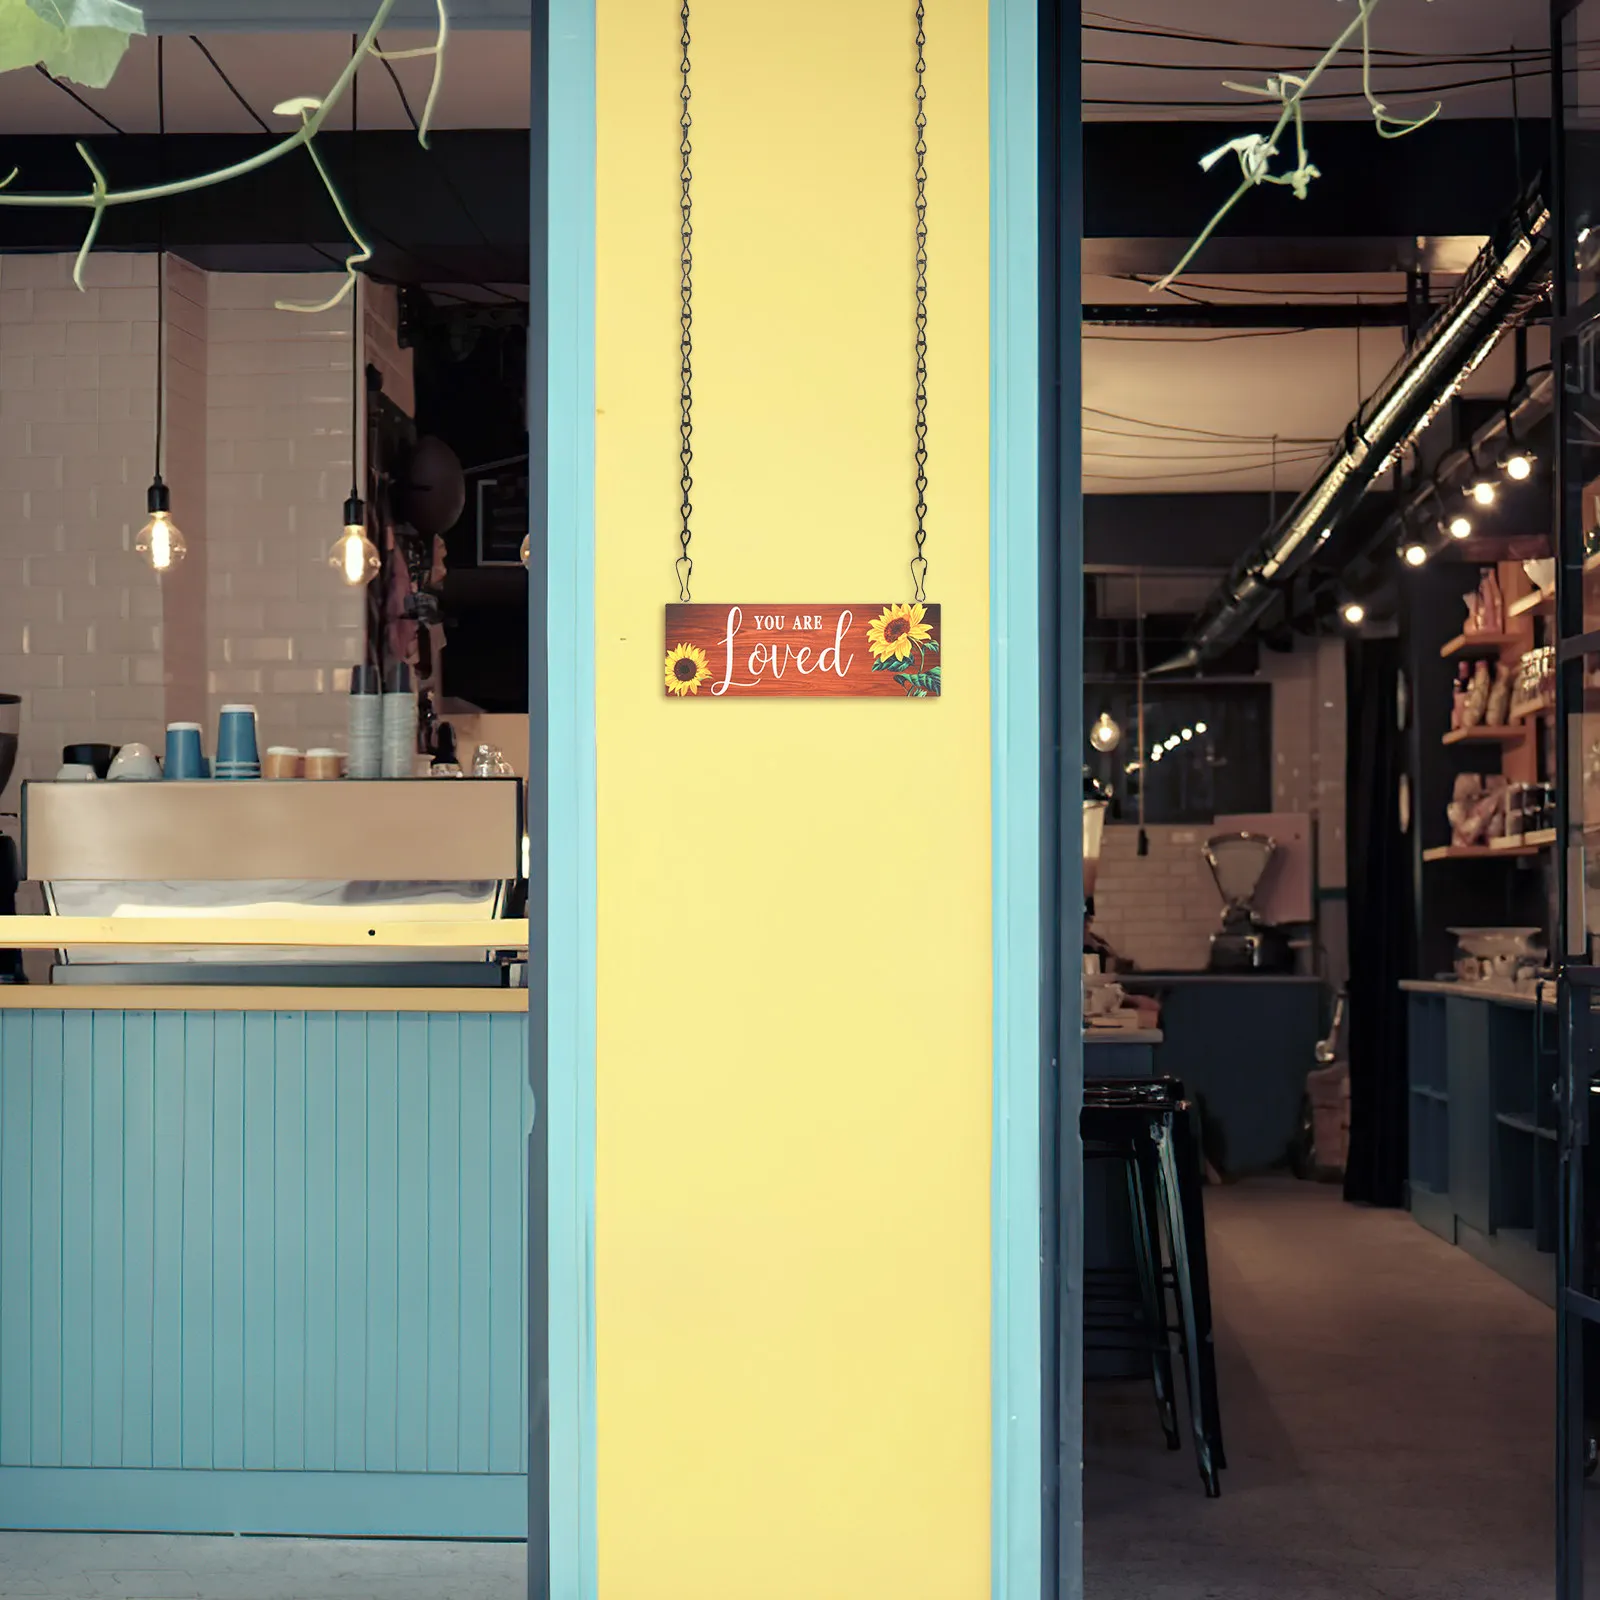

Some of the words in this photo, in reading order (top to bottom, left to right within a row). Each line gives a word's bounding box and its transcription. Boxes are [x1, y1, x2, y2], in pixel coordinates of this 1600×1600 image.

[754, 615, 785, 630] YOU
[792, 615, 823, 630] ARE
[711, 606, 854, 695] Loved
